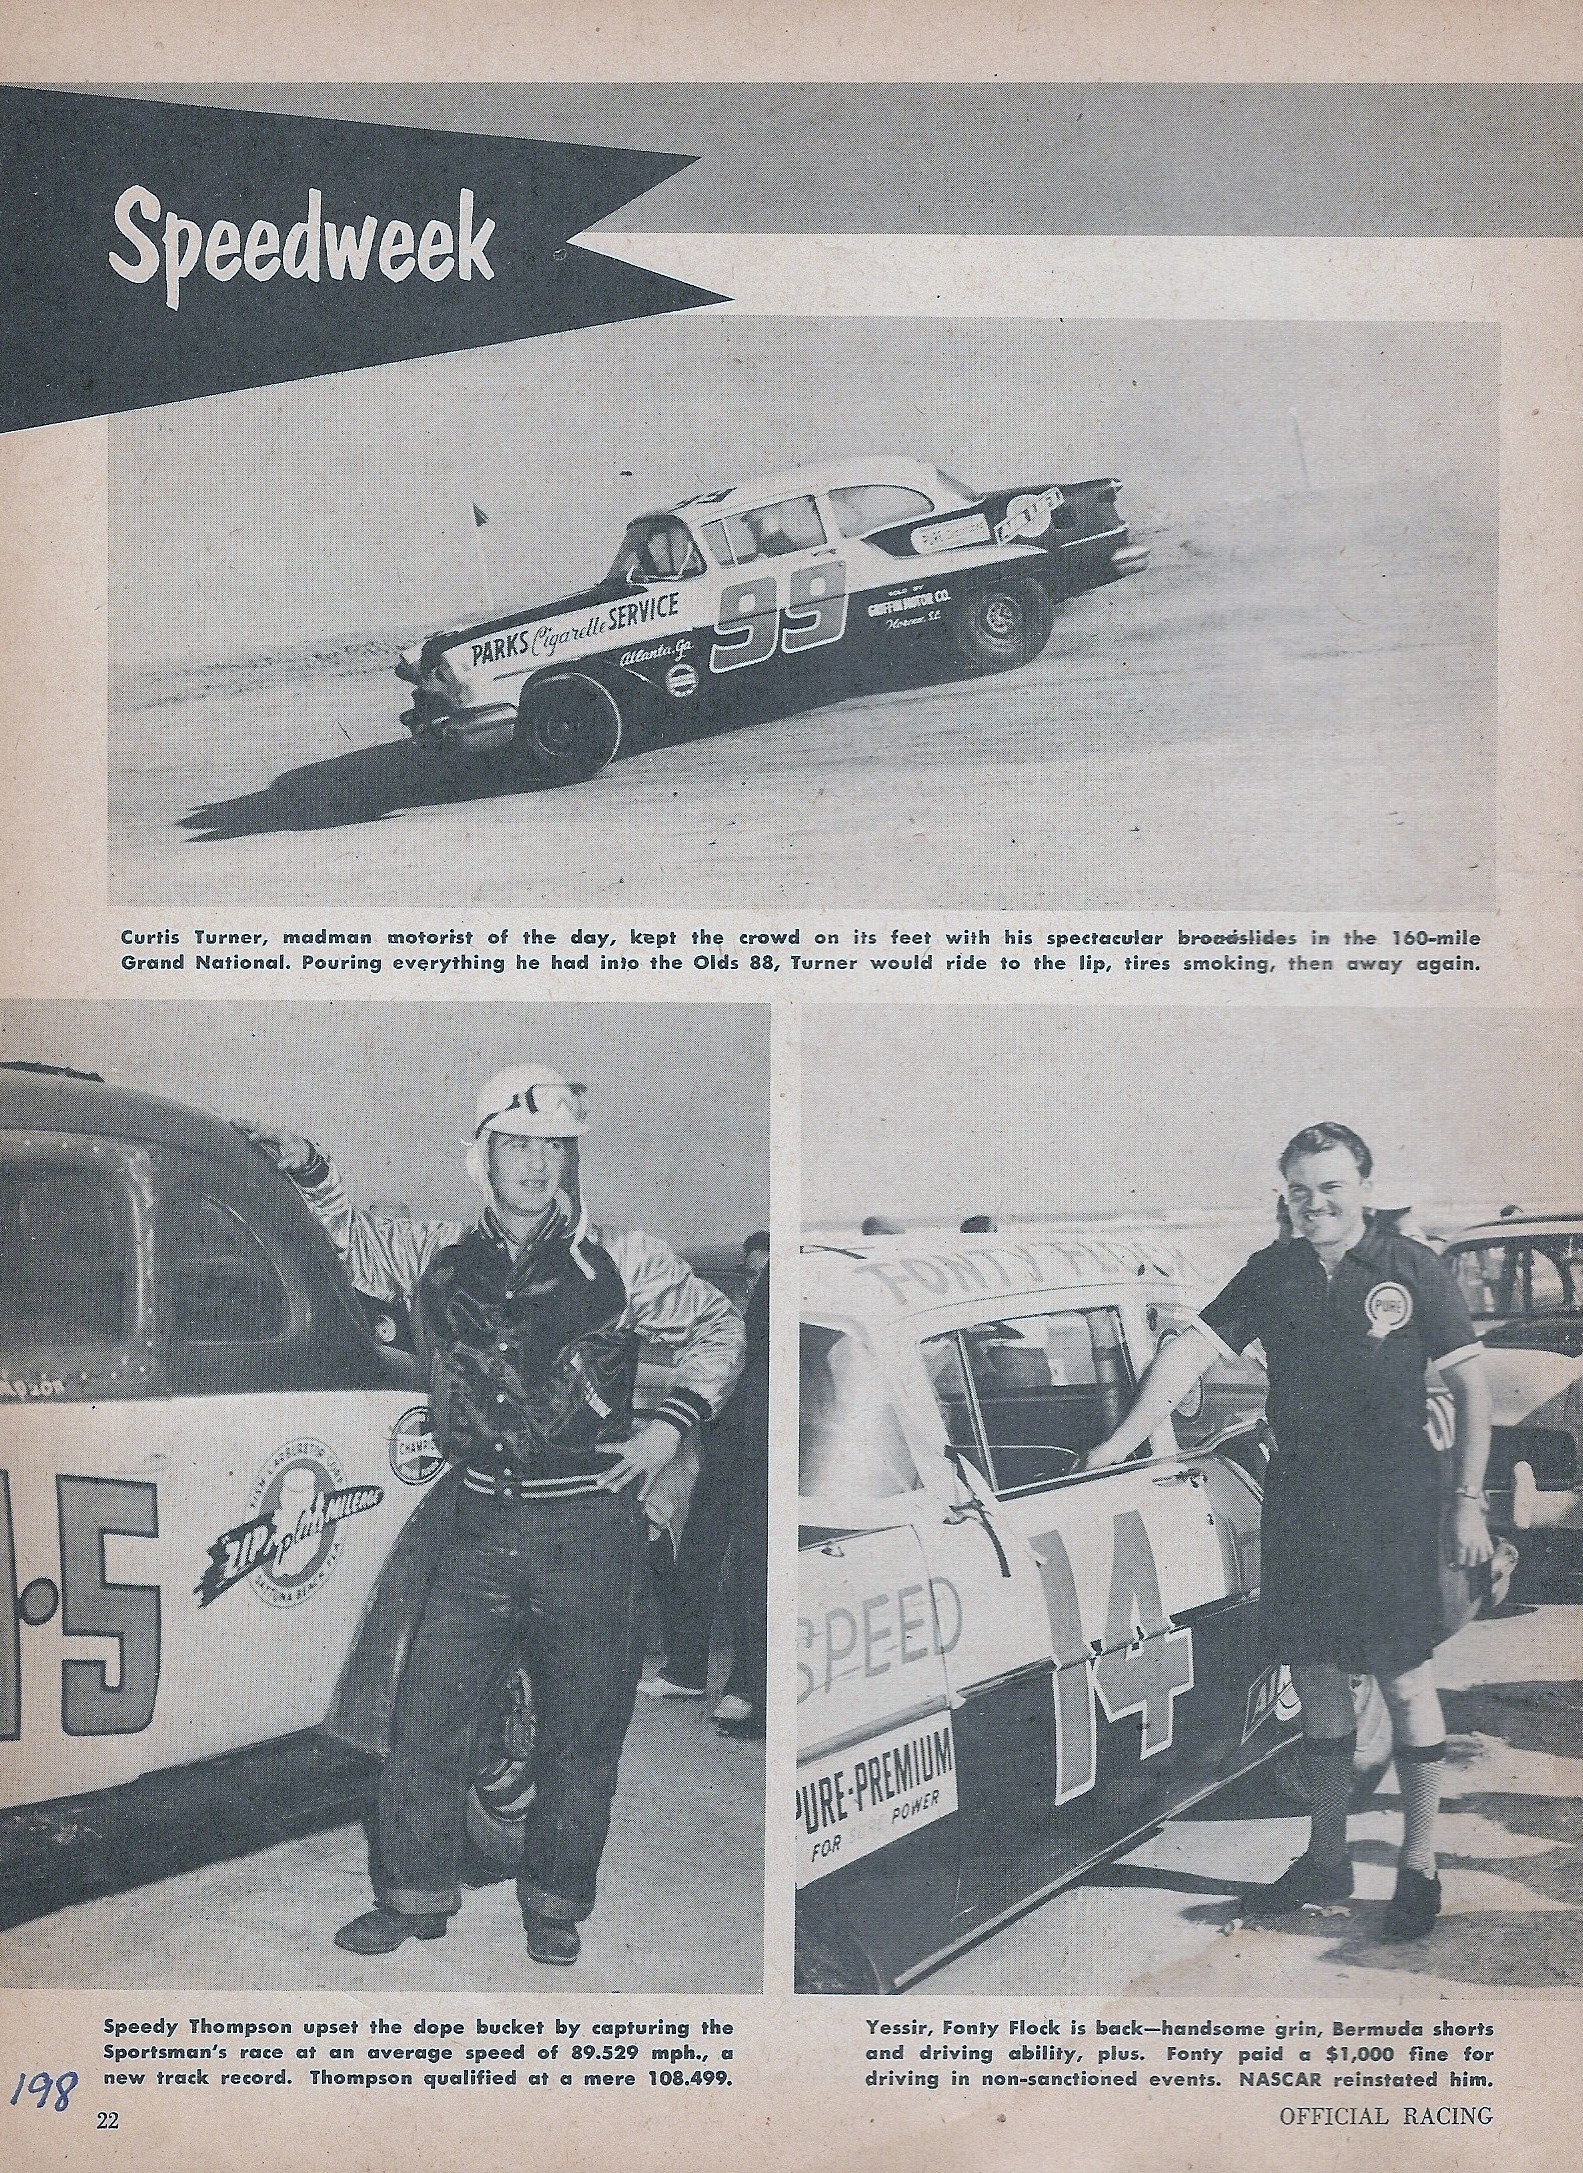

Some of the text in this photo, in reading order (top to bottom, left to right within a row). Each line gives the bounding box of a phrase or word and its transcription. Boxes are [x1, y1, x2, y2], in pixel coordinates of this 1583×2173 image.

[108, 184, 496, 311] Speedweek
[934, 589, 952, 603] CO.
[708, 560, 850, 675] 99
[471, 592, 680, 668] PARKS Cigarette SERVICE
[121, 928, 1481, 949] Curtis Turner, madman motorist of the day, kept the crowd on its feet with his spectacular broadslides in the 160-mile
[121, 953, 1480, 975] Grand National. Pouring everything he had into the Olds 88, Turner would ride to the lip, tires smoking, then away again.
[853, 1244, 1044, 1306] FONTY
[1375, 1299, 1402, 1314] PURE
[222, 1523, 269, 1579] ZIP
[1027, 1509, 1195, 1807] 14
[811, 1833, 842, 1863] FOR
[891, 1788, 940, 1825] POWER
[103, 2017, 734, 2039] Speedy Thompson upset the dope bucket by capturing the
[866, 2019, 1494, 2040] Yessir, Fonty Flock is back—handsome grin, Bermuda shorts
[103, 2044, 733, 2064] Sportsman's race at an average speed of 89.529 mph., a
[865, 2044, 1495, 2065] and driving ability, plus. Fonty paid a $1,000 fine for
[104, 2068, 733, 2090] new track record. Thompson qualified at a mere 108.499.
[865, 2070, 1493, 2090] driving in non-sanctioned events. NASCAR reinstated him.
[9, 2070, 80, 2113] 198
[96, 2111, 119, 2130] 22
[1280, 2106, 1493, 2126] OFFICIAL RACING
